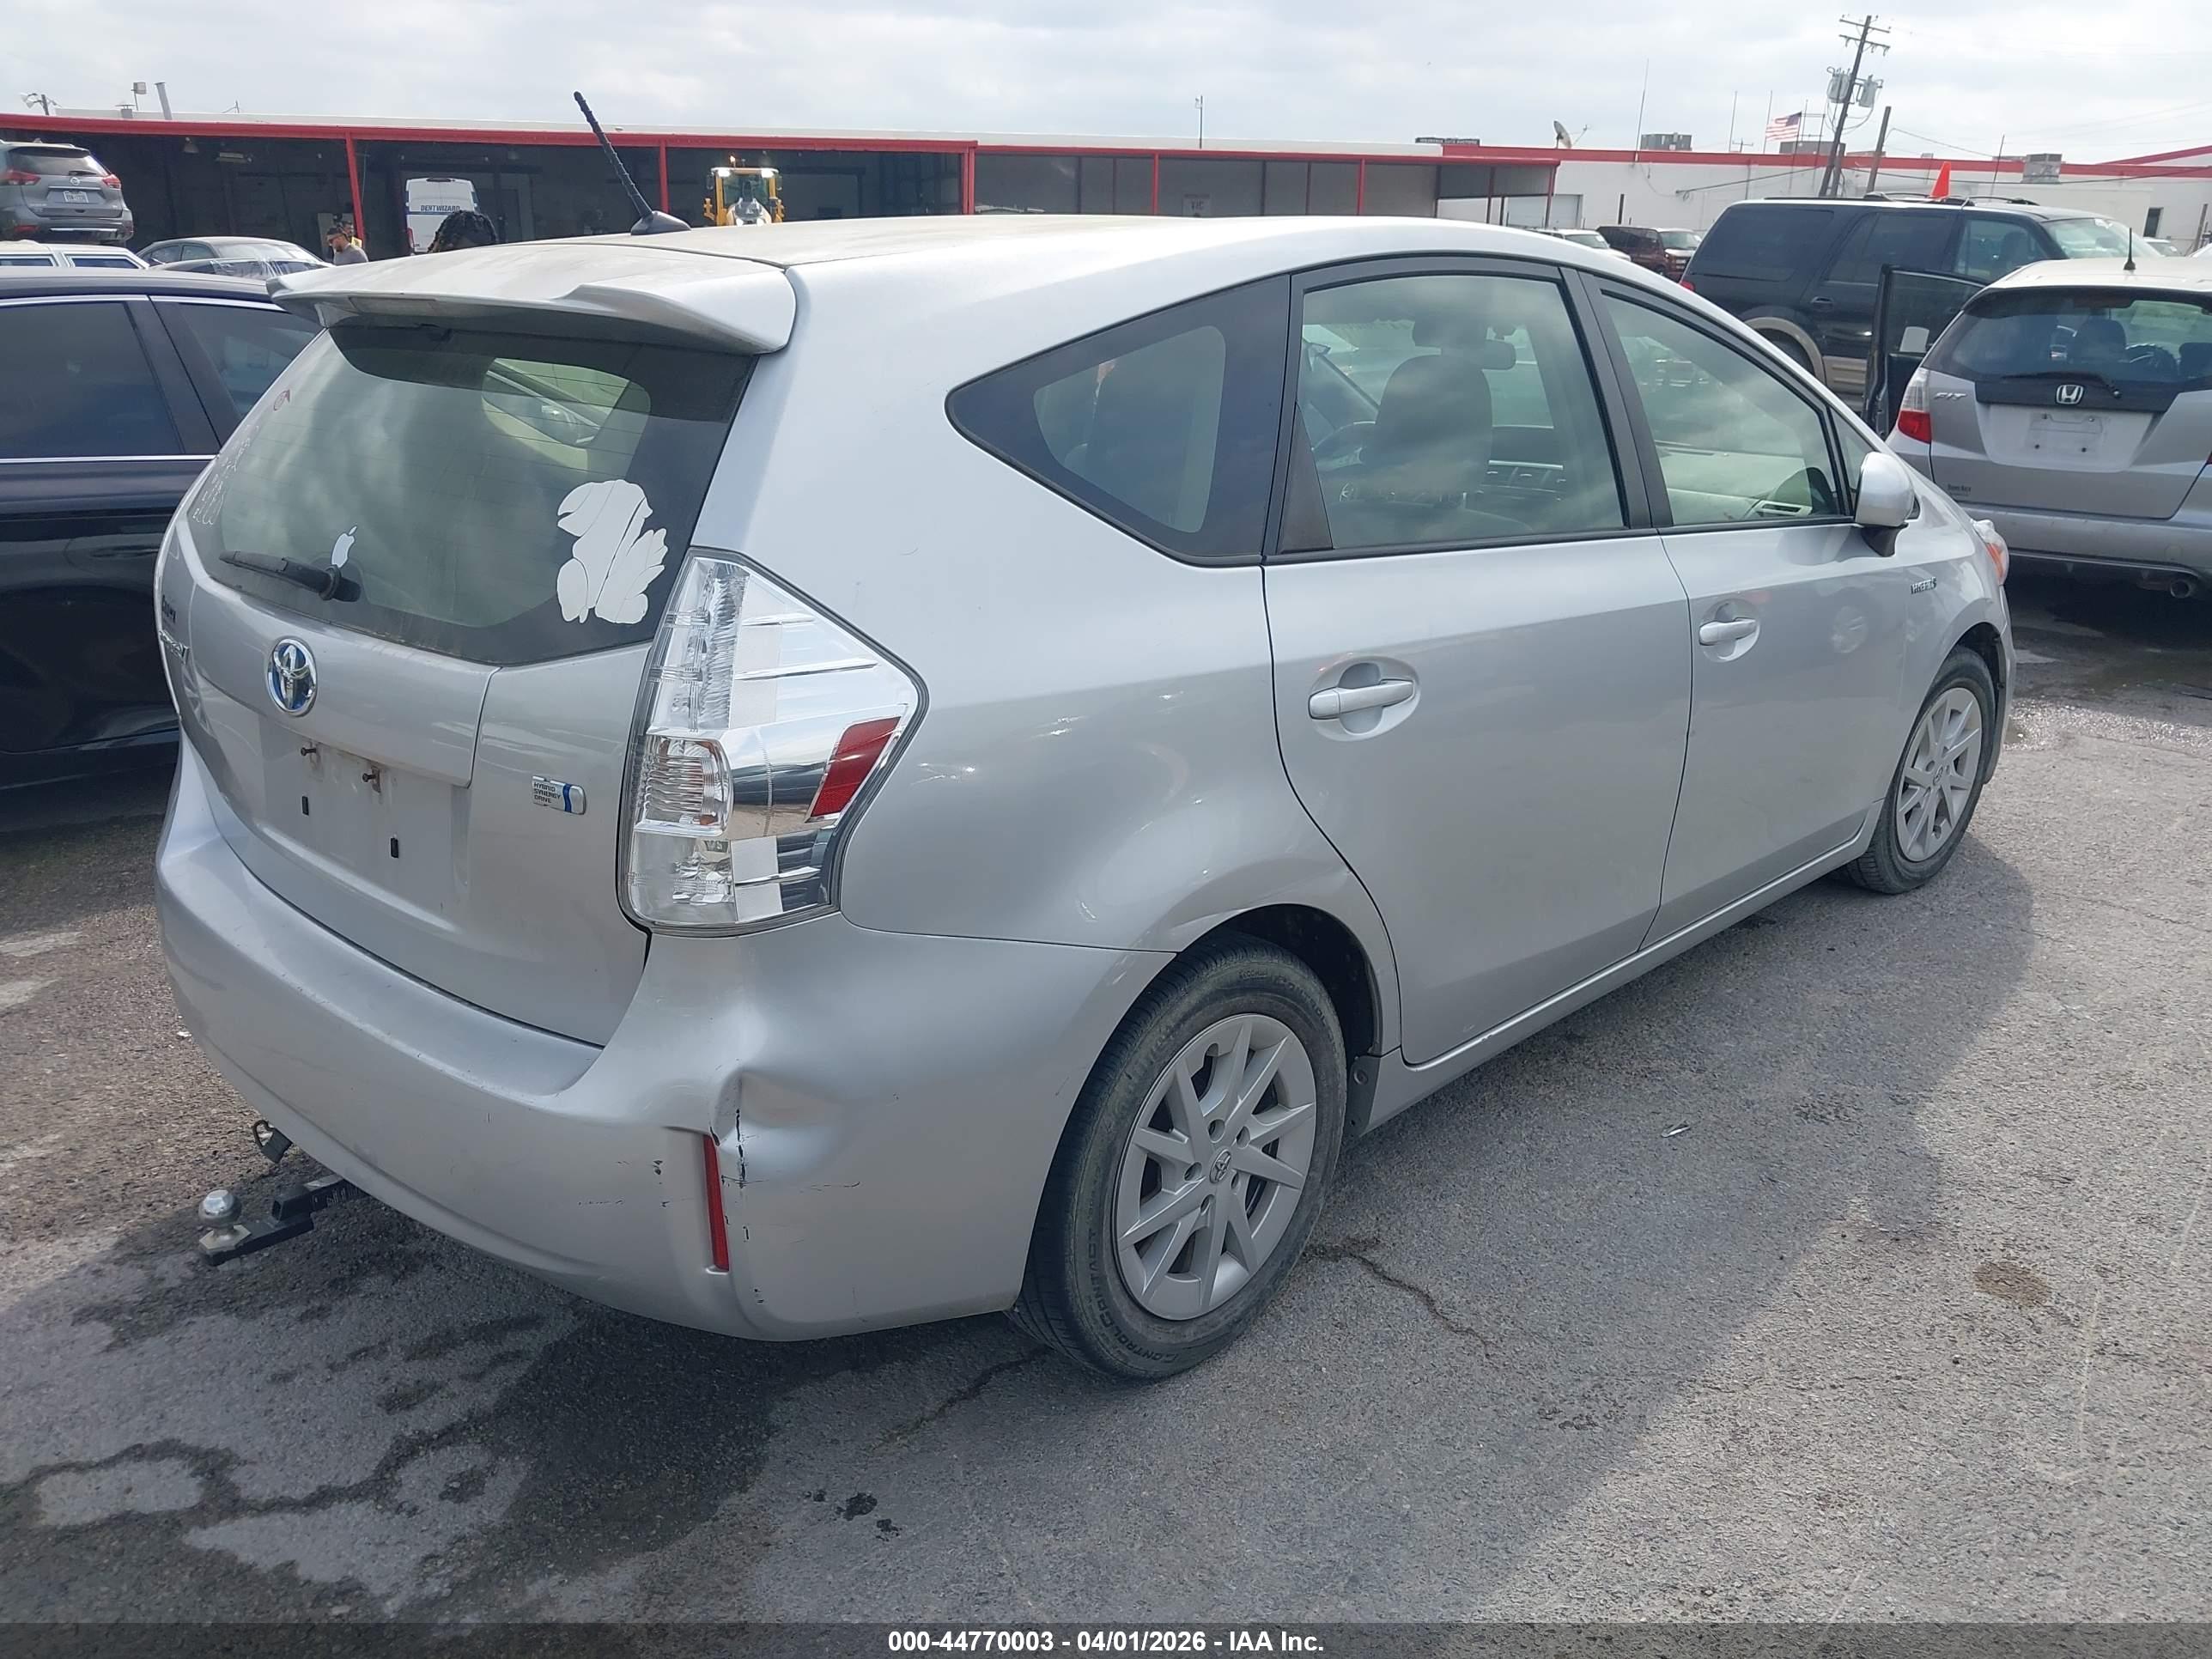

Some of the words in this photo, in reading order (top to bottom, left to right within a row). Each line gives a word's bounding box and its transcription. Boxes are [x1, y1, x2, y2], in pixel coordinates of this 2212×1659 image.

[533, 781, 556, 792] HYBRID
[533, 788, 561, 799] SYNERGY
[534, 794, 552, 804] DRIVE
